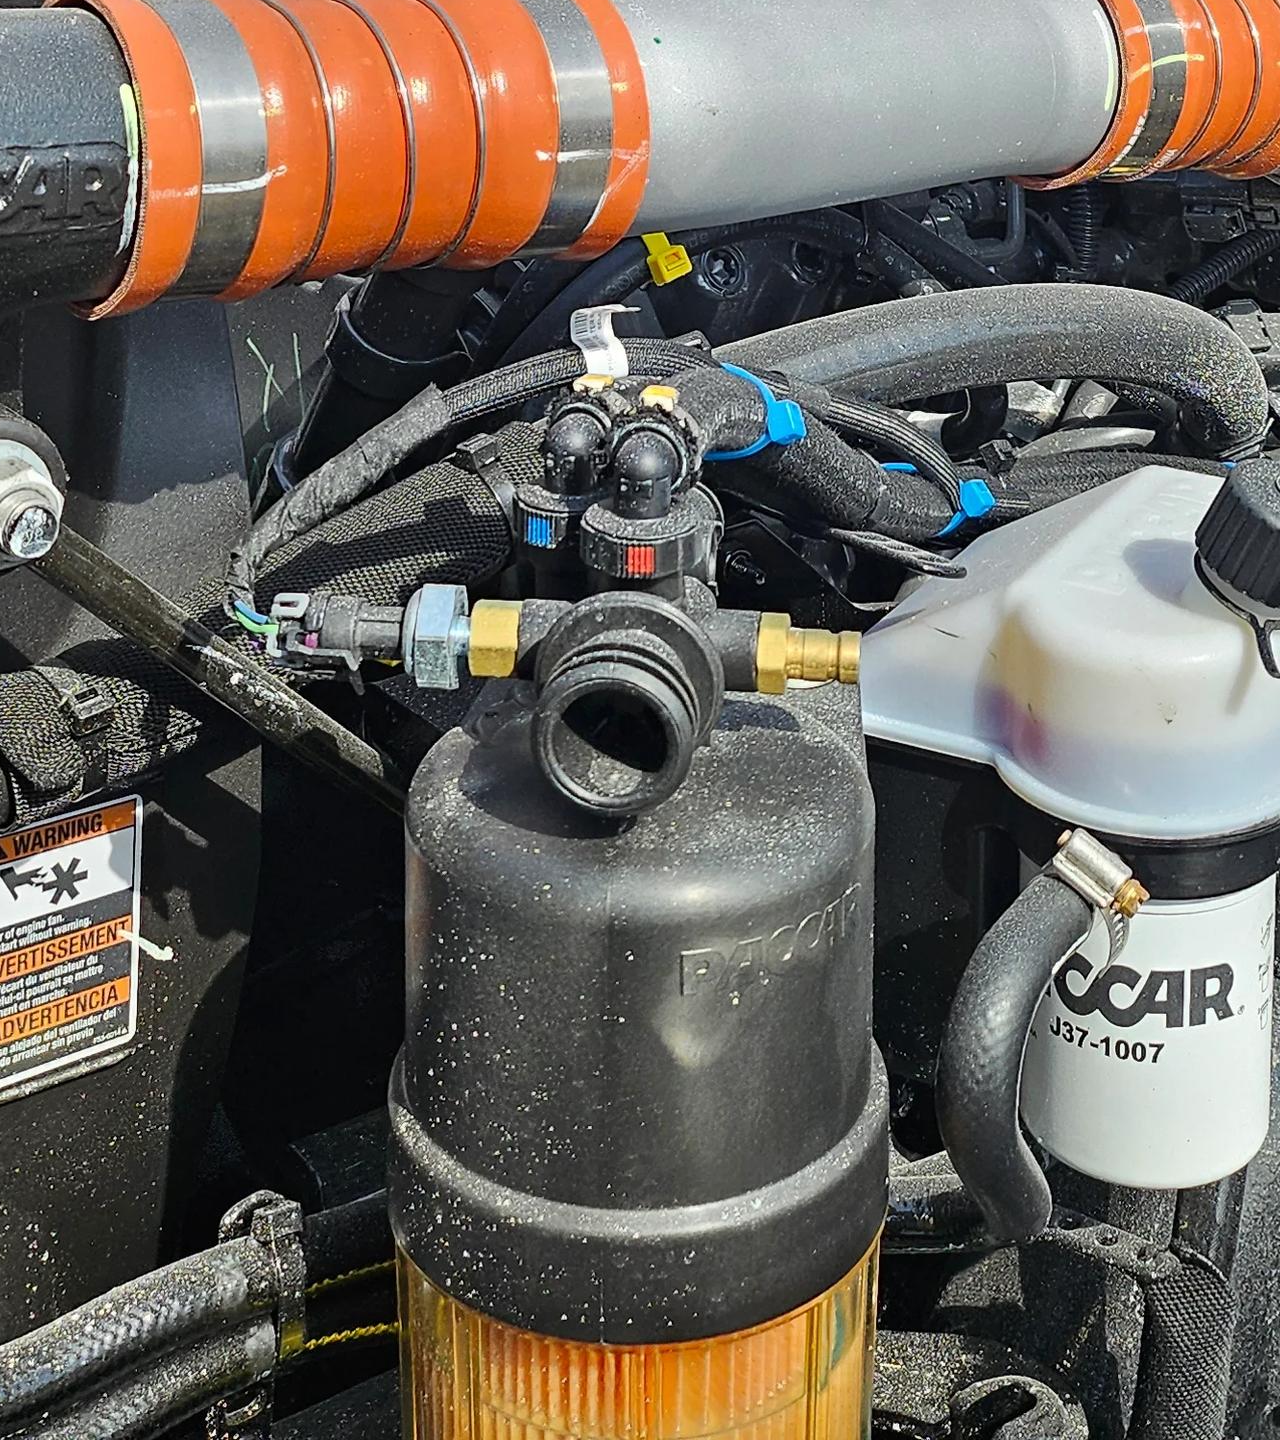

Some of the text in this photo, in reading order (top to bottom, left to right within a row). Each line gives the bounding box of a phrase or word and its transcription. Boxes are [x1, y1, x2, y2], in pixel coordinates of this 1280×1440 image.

[12, 812, 103, 857] WARNING
[5, 929, 15, 941] of
[16, 919, 47, 937] engine
[47, 914, 66, 927] fan.
[19, 929, 53, 948] without
[54, 917, 92, 938] warning.
[25, 975, 38, 987] du
[38, 960, 86, 984] ventilateur
[86, 954, 98, 967] du
[26, 977, 62, 998] pourrait
[62, 974, 74, 985] se
[74, 964, 104, 981] mettre
[19, 1000, 30, 1011] en
[1049, 951, 1235, 1029] CCAR
[9, 1036, 43, 1057] alejado
[44, 1028, 57, 1042] del
[58, 1014, 102, 1036] ventilador
[103, 1007, 117, 1021] del
[12, 1044, 50, 1064] arrancar
[52, 1037, 66, 1050] sin
[67, 1027, 95, 1046] previo
[1049, 1016, 1165, 1064] J37-1007
